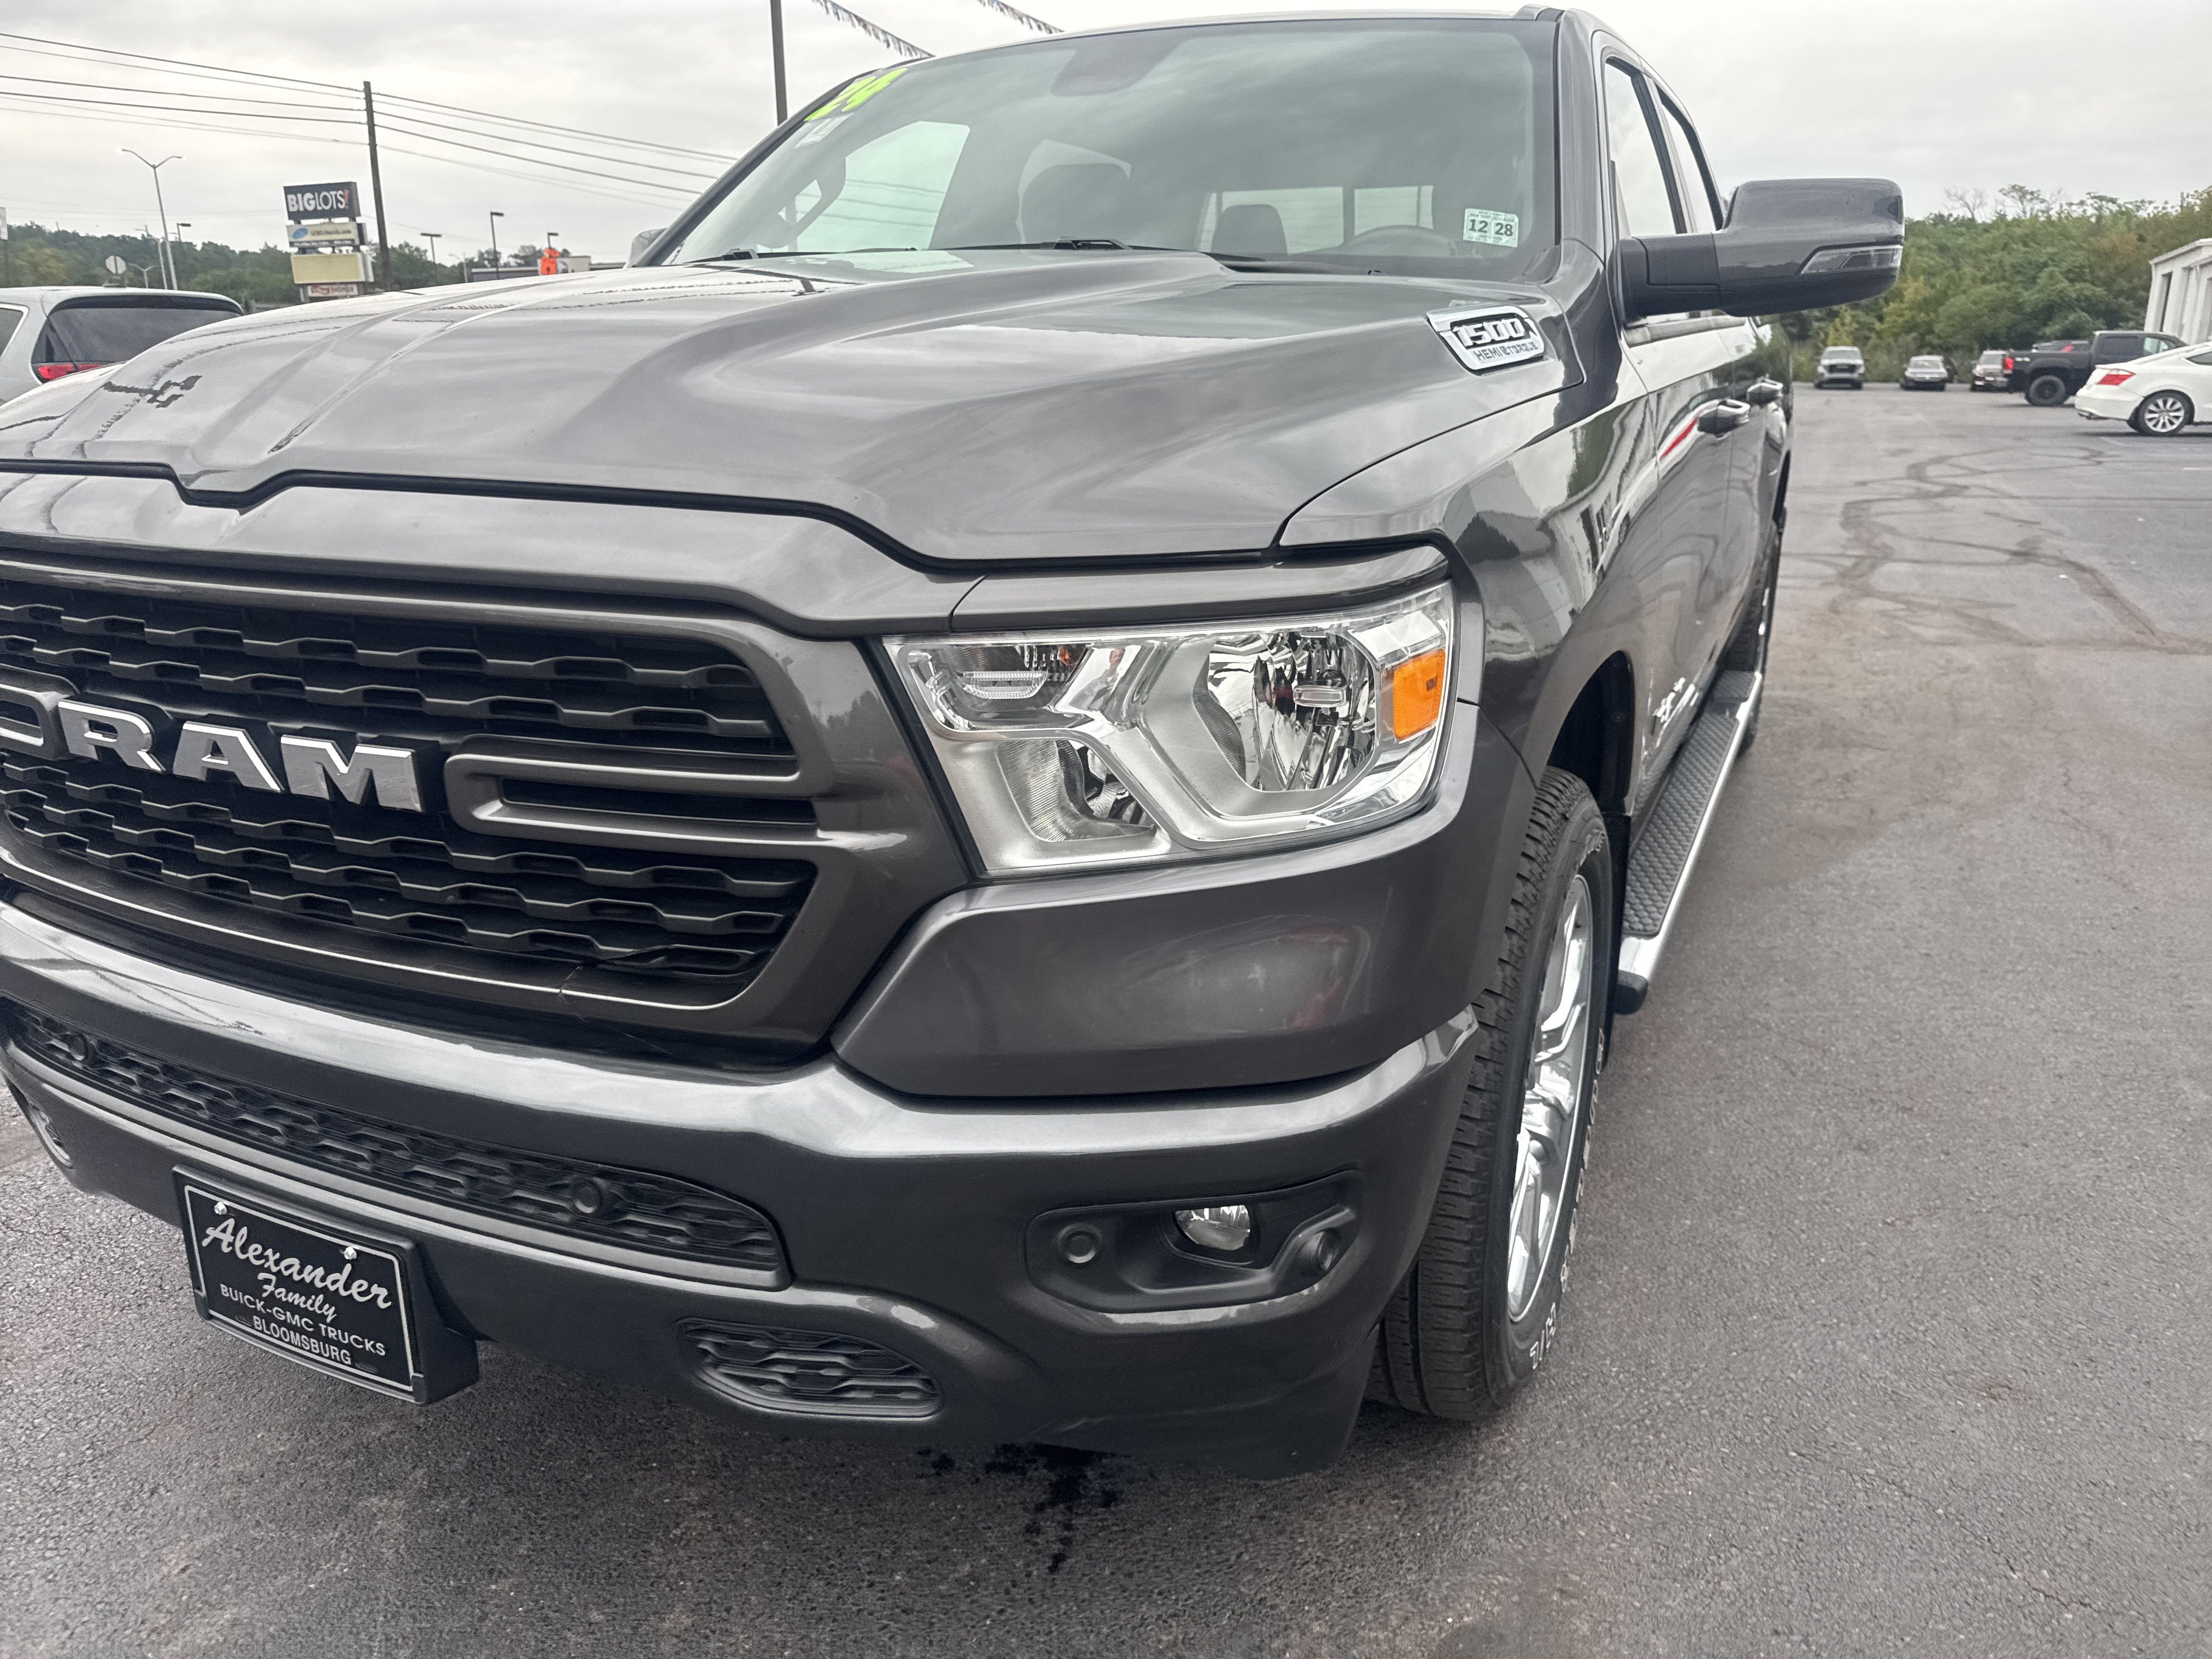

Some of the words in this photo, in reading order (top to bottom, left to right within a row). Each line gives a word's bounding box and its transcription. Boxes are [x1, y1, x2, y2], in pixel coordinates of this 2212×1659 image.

[1469, 219, 1488, 233] 12
[1494, 222, 1514, 236] 28
[1453, 318, 1526, 347] 1500
[1473, 346, 1503, 361] HEMI
[58, 699, 422, 812] RAM
[202, 1218, 392, 1309] Alexander
[219, 1283, 314, 1332] BUICK-GMC
[319, 1324, 386, 1356] TRUCKS
[258, 1273, 337, 1323] Family
[252, 1315, 352, 1365] BLOOMSBURG
